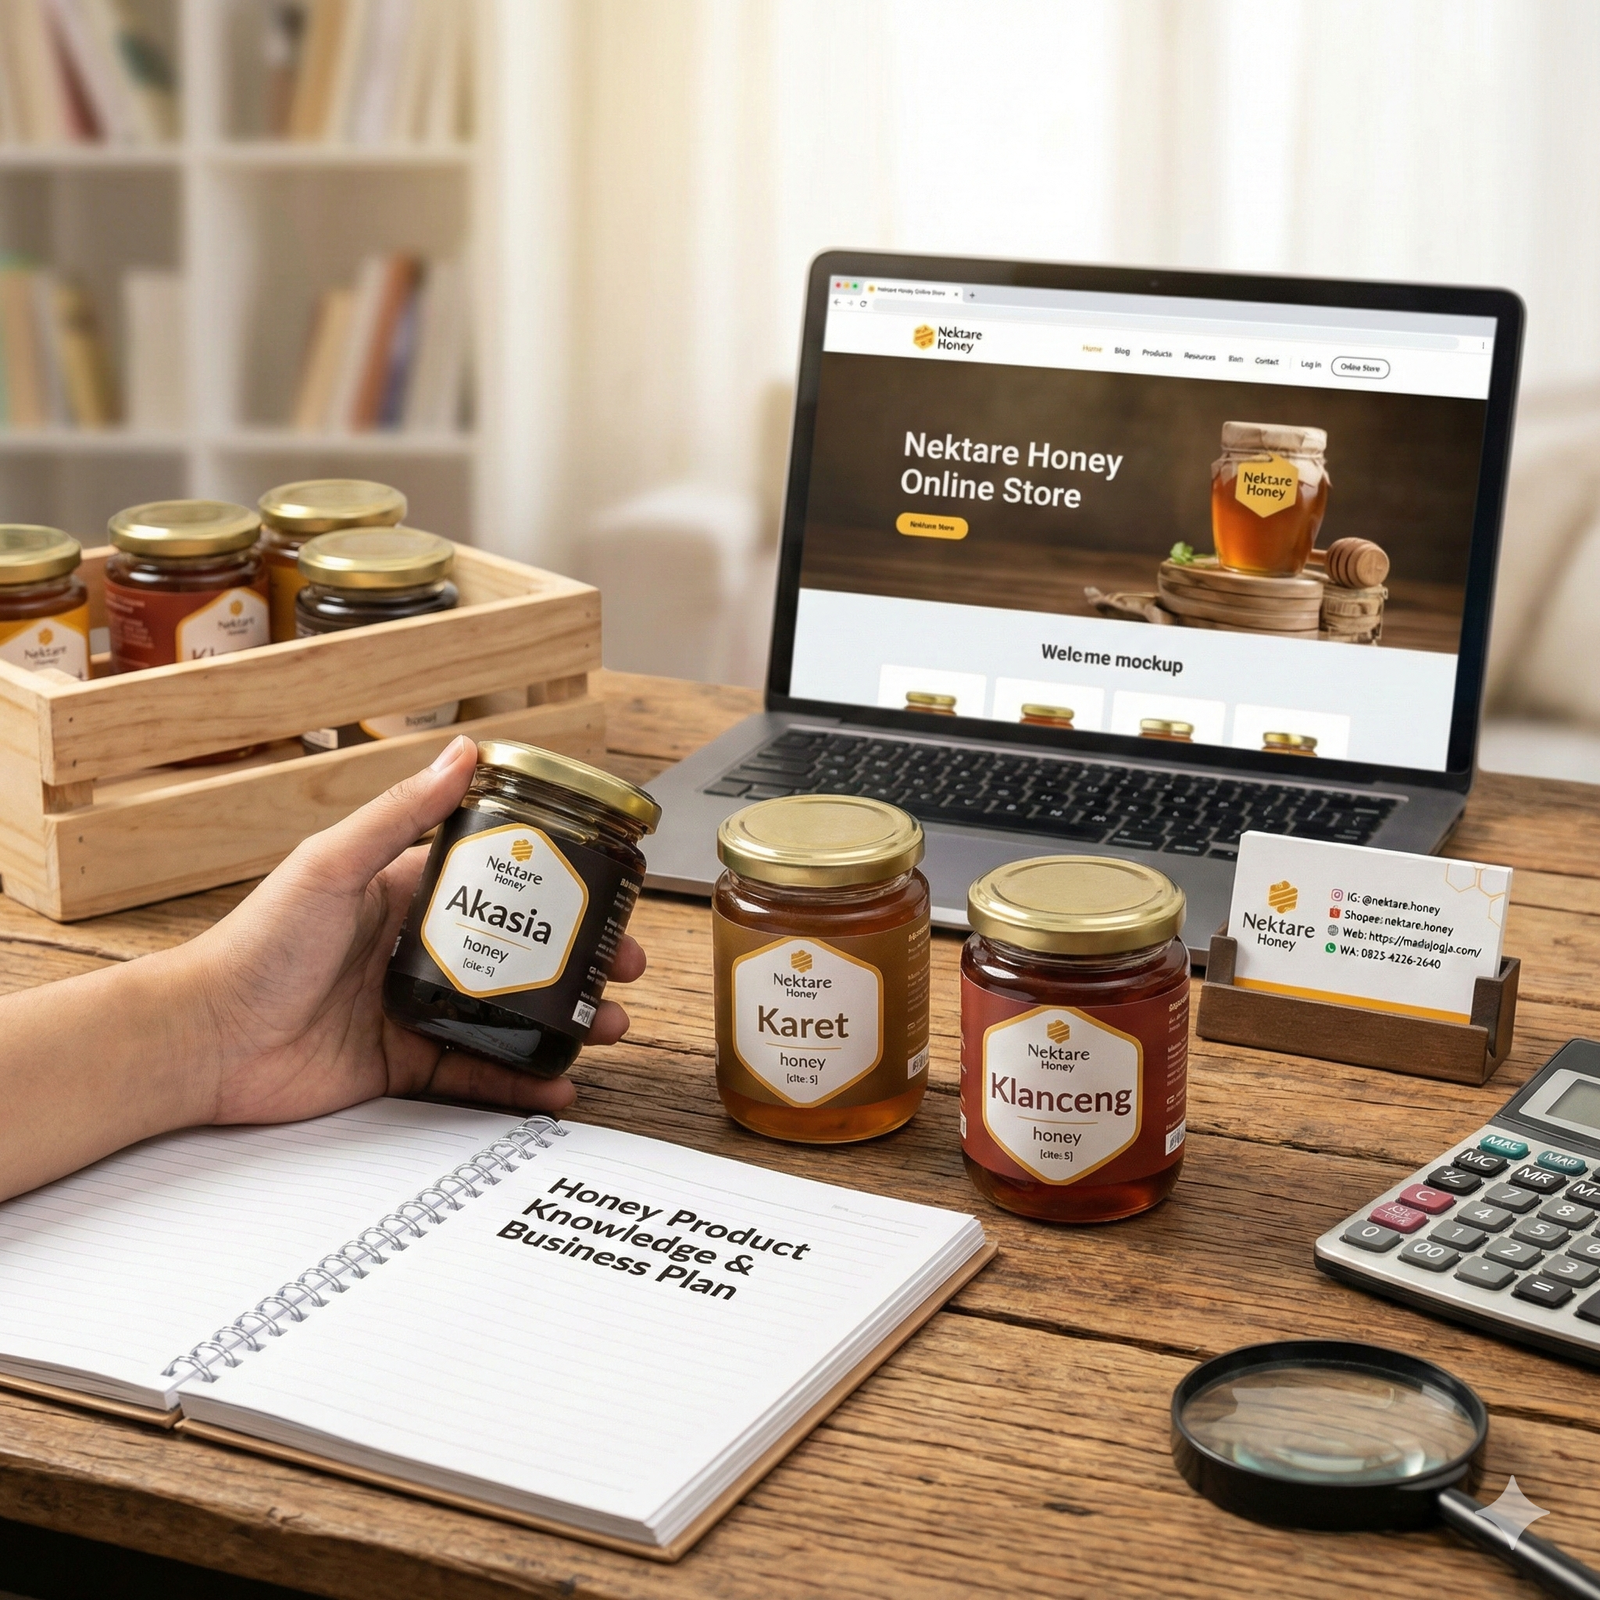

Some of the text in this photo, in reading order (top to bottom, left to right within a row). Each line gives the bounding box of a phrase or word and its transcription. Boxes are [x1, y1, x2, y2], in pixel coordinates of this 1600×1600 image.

[938, 326, 983, 341] Nektare
[937, 339, 974, 354] Honey
[1082, 344, 1103, 353] Home
[1114, 347, 1130, 357] Blog
[1254, 357, 1279, 366] Contact
[903, 431, 1124, 481] Nektare Honey
[1243, 471, 1293, 487] Nektare
[901, 468, 1082, 509] Online Store
[1246, 484, 1286, 501] Honey
[1115, 655, 1183, 677] mockup
[486, 855, 543, 886] Nektare
[494, 873, 527, 892] Honey
[1346, 892, 1361, 903] IG:
[444, 885, 553, 945] Akasia
[1344, 909, 1384, 924] Shopee:
[1242, 912, 1316, 939] Nektare
[1343, 927, 1367, 940] Web:
[462, 935, 510, 964] honey
[1257, 932, 1297, 952] Honey
[1339, 945, 1360, 957] WA:
[773, 972, 833, 989] Nektare
[786, 988, 818, 1000] Honey
[758, 1005, 849, 1039] Karet
[1028, 1043, 1091, 1061] Nektare
[780, 1052, 827, 1071] honey
[1041, 1060, 1075, 1073] Honey
[991, 1072, 1133, 1116] Klanceng
[1033, 1126, 1082, 1145] honey
[1461, 1151, 1498, 1167] MC
[1517, 1167, 1555, 1184] MR
[1415, 1190, 1437, 1202] C
[1501, 1188, 1522, 1199] 7
[1474, 1208, 1494, 1219] 4
[1556, 1205, 1576, 1216] 8
[547, 1177, 811, 1262] Honey Product
[522, 1198, 755, 1277] Knowledge &
[1451, 1228, 1464, 1238] 1
[1530, 1224, 1551, 1236] 5
[1413, 1242, 1445, 1258] 00
[1505, 1243, 1522, 1257] 2
[1586, 1244, 1600, 1254] 6
[496, 1219, 738, 1301] Business Plan
[1558, 1261, 1579, 1273] 3
